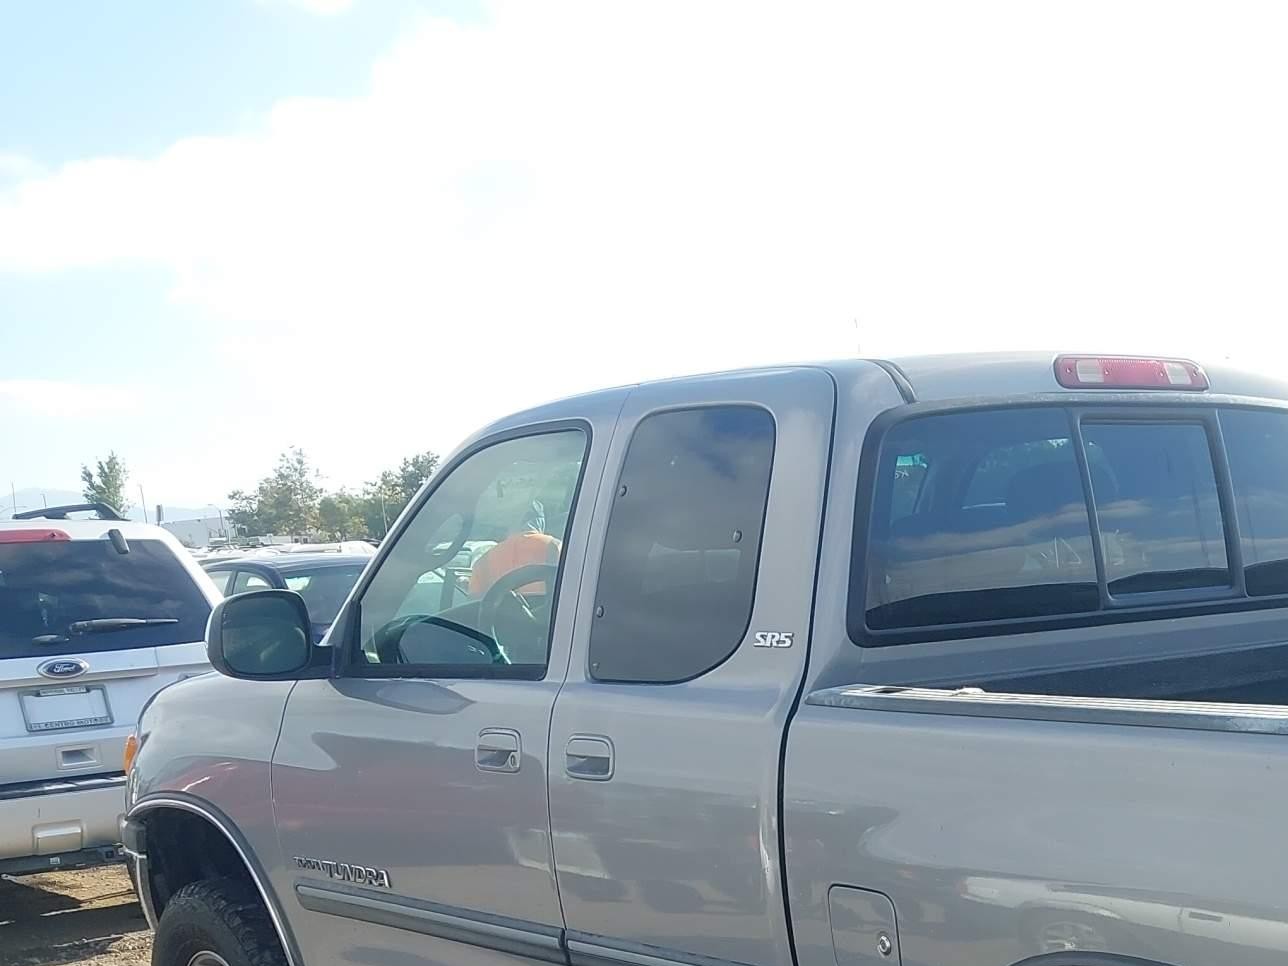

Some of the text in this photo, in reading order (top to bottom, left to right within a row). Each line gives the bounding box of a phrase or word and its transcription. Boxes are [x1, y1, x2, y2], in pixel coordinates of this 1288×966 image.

[753, 631, 793, 648] SR5
[53, 662, 76, 673] Ford
[321, 860, 392, 888] TUNDRA
